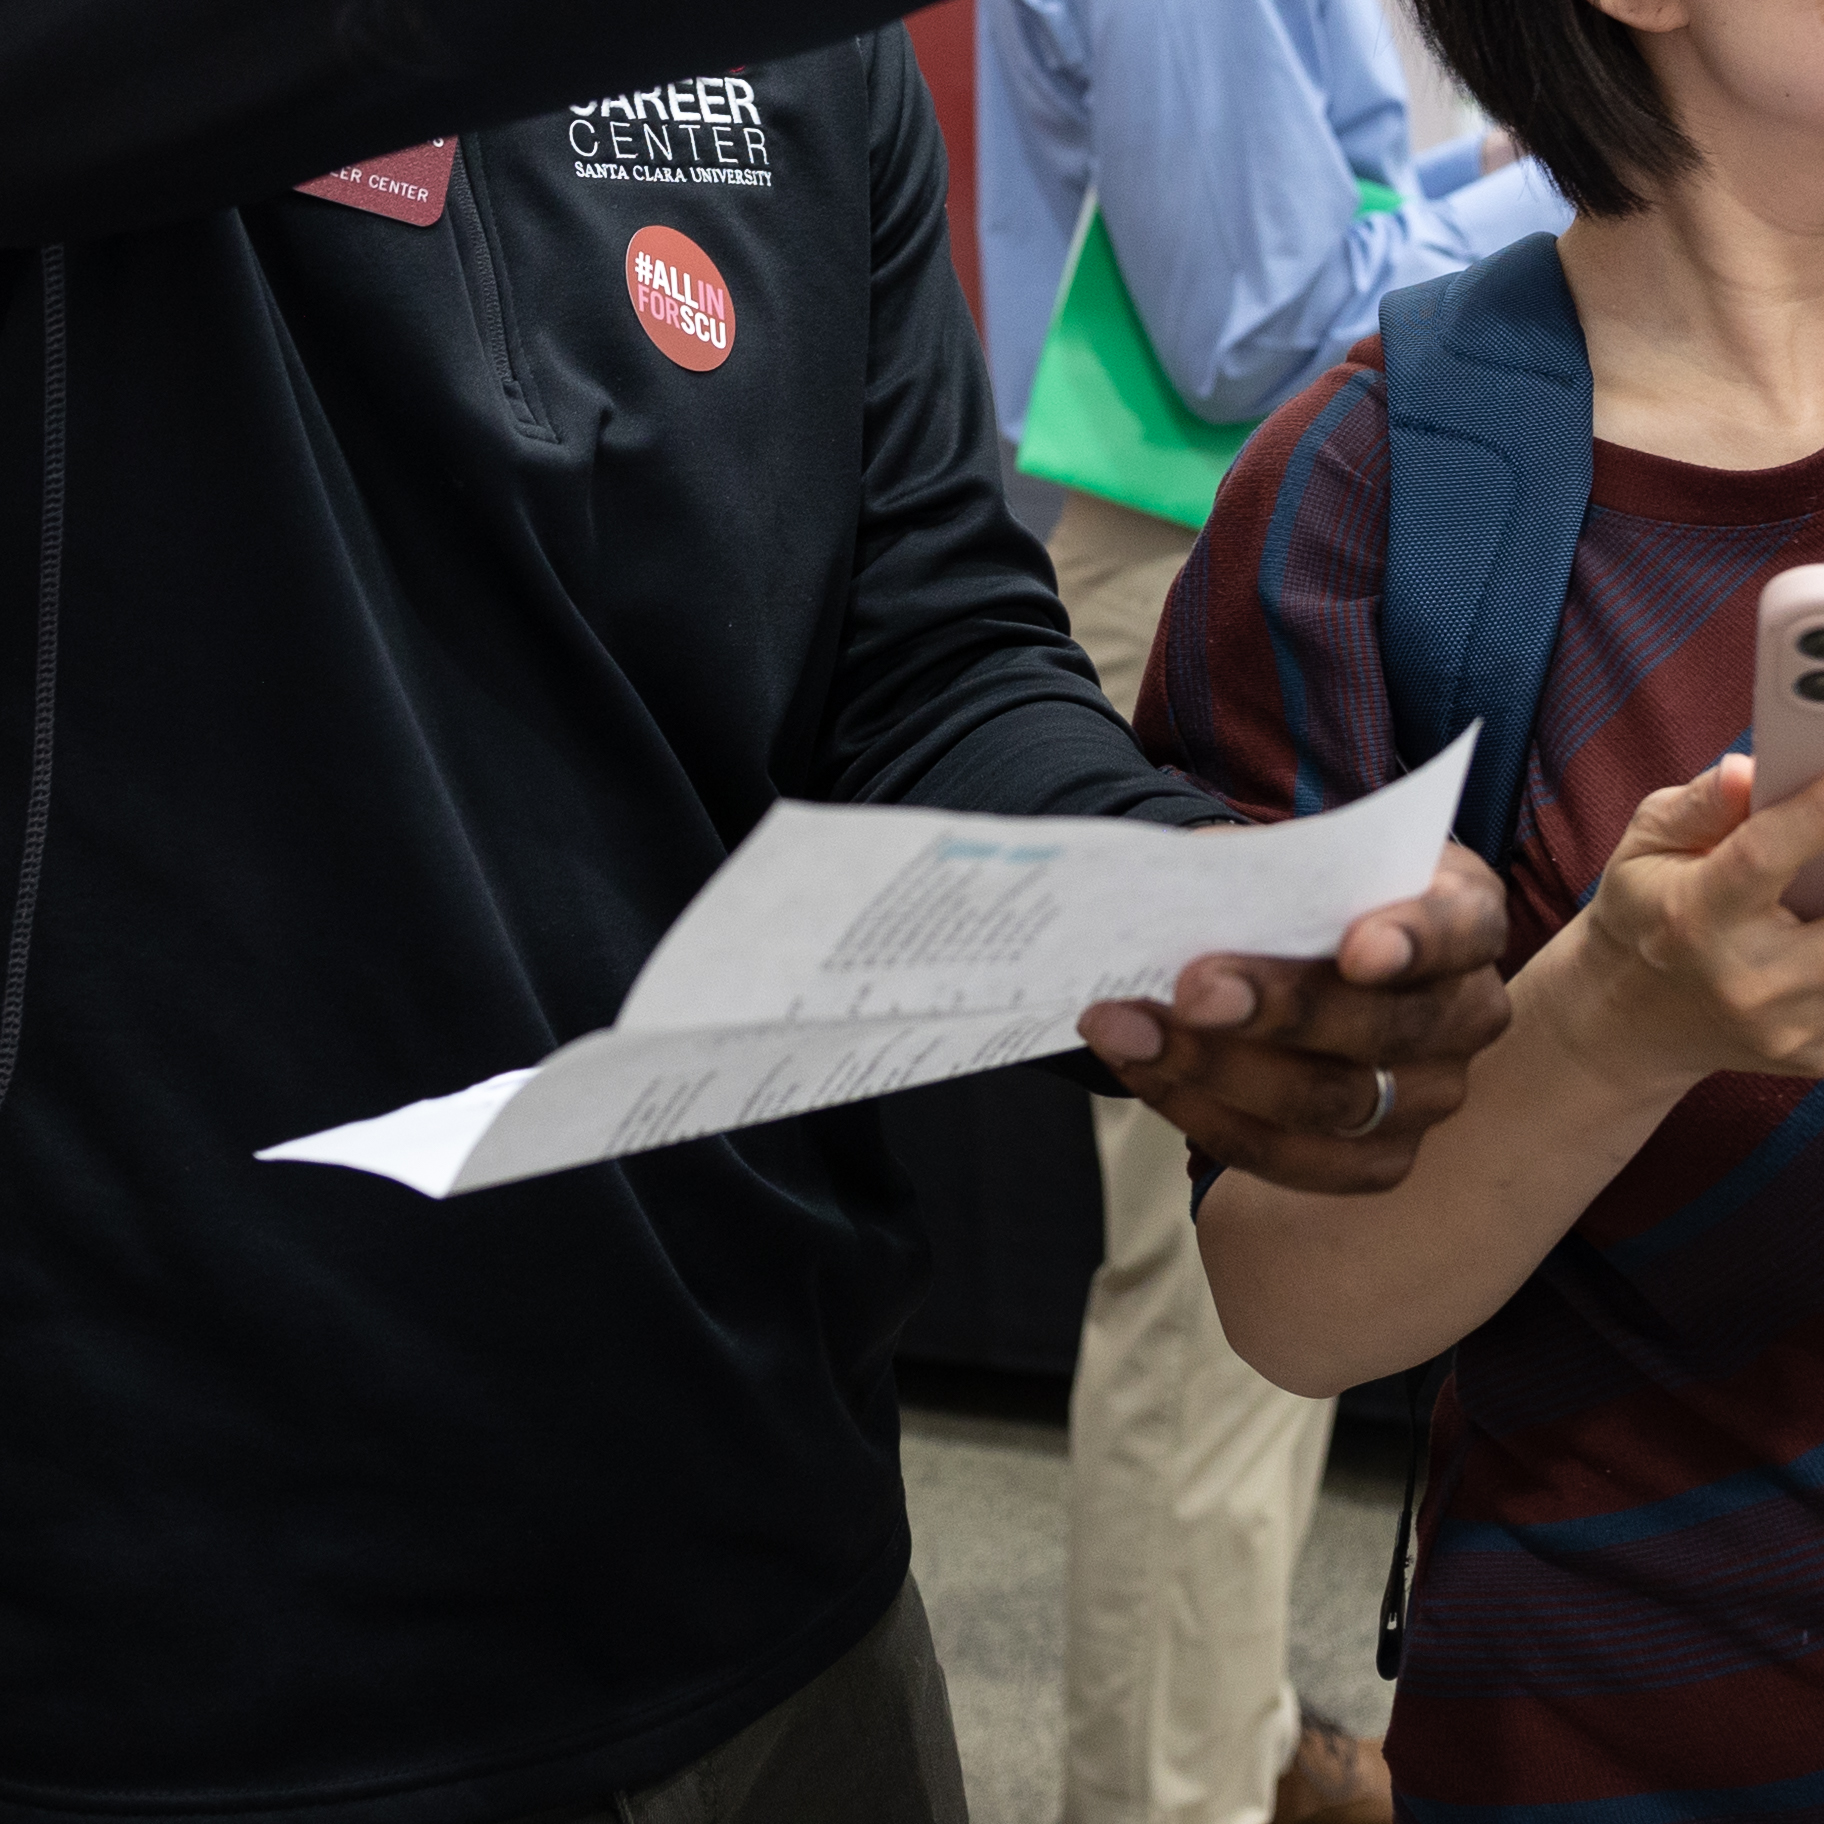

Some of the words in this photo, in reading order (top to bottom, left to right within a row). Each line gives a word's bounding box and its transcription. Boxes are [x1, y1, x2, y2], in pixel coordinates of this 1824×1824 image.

[569, 119, 770, 165] CENTER
[574, 161, 629, 180] SANTA
[632, 164, 687, 183] CLARA
[689, 166, 772, 186] UNIVERSITY
[368, 174, 429, 203] CENTER
